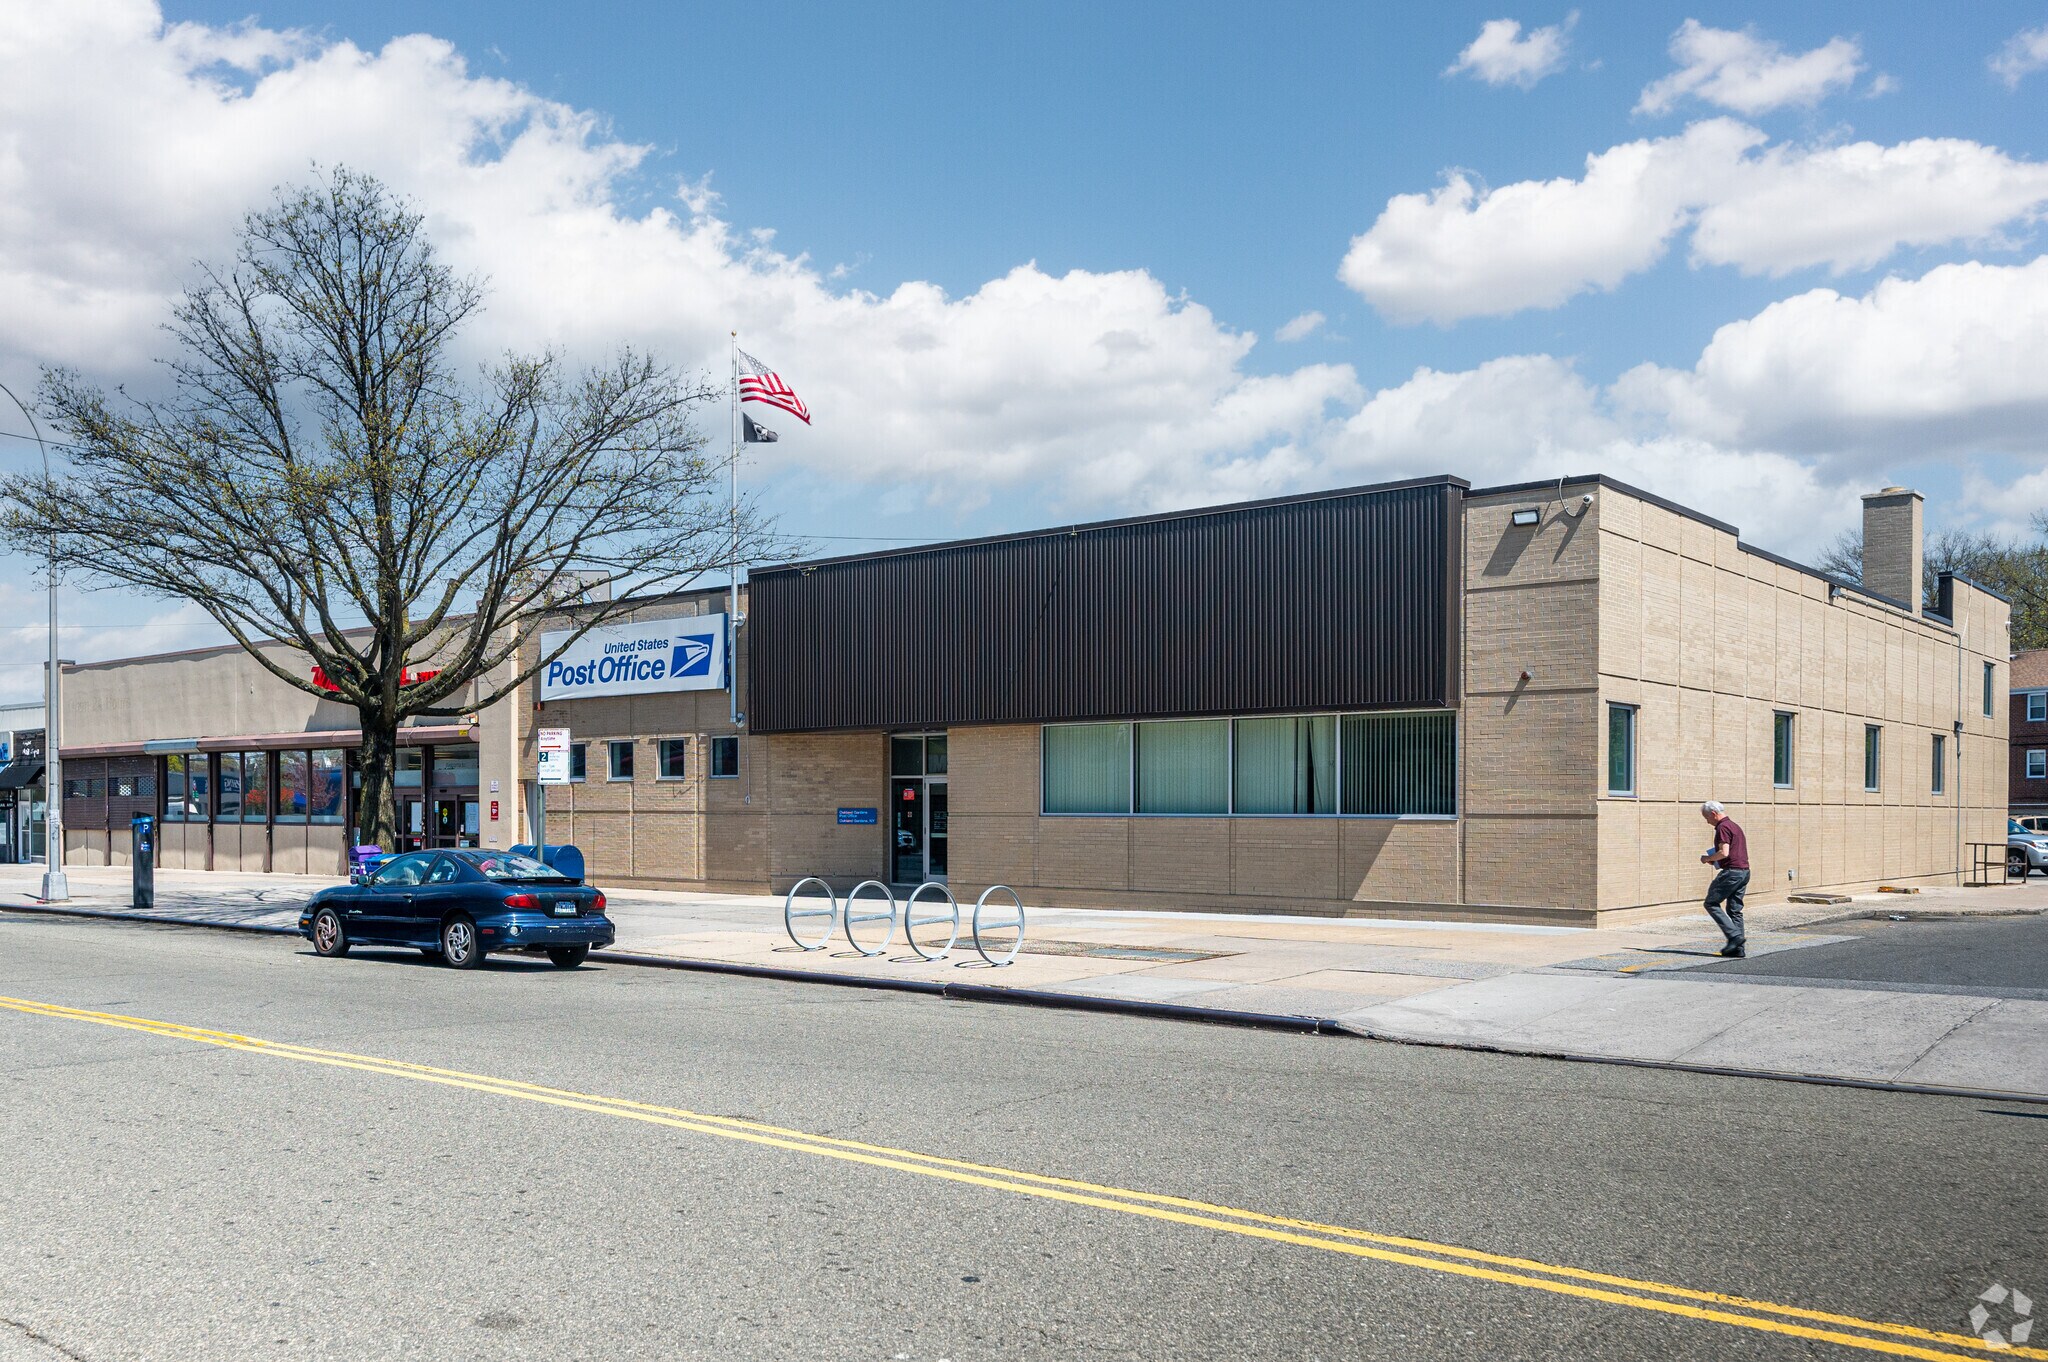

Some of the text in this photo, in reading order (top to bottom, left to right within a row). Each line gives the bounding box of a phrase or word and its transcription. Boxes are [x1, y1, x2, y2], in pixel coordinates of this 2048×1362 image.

[604, 639, 669, 655] United States
[547, 654, 666, 687] Post Office
[541, 752, 547, 762] 2
[143, 824, 149, 833] P
